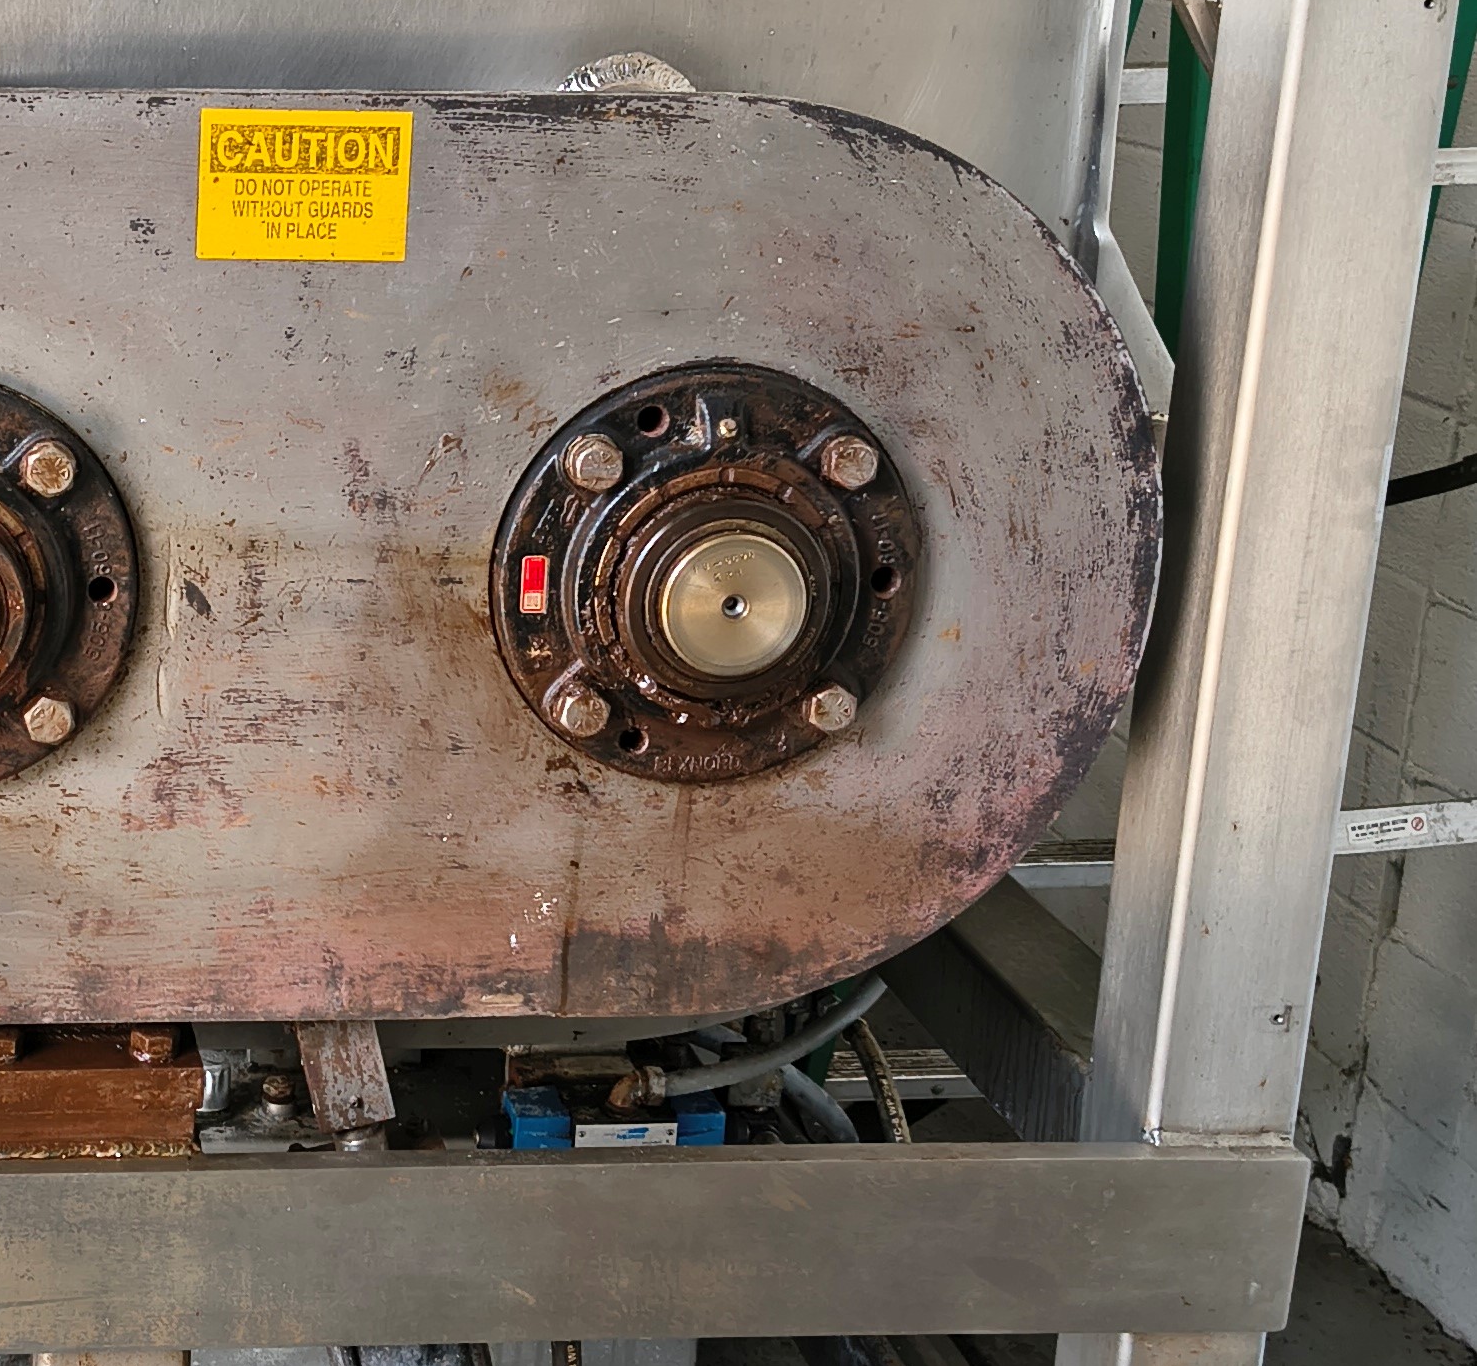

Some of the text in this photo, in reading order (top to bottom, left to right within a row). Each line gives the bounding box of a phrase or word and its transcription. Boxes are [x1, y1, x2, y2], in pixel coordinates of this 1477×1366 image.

[216, 130, 394, 170] CAUTION
[234, 178, 372, 197] DO NOT OPERATE
[232, 200, 374, 219] WITHOUT GUARDS
[266, 222, 337, 240] IN PLACE
